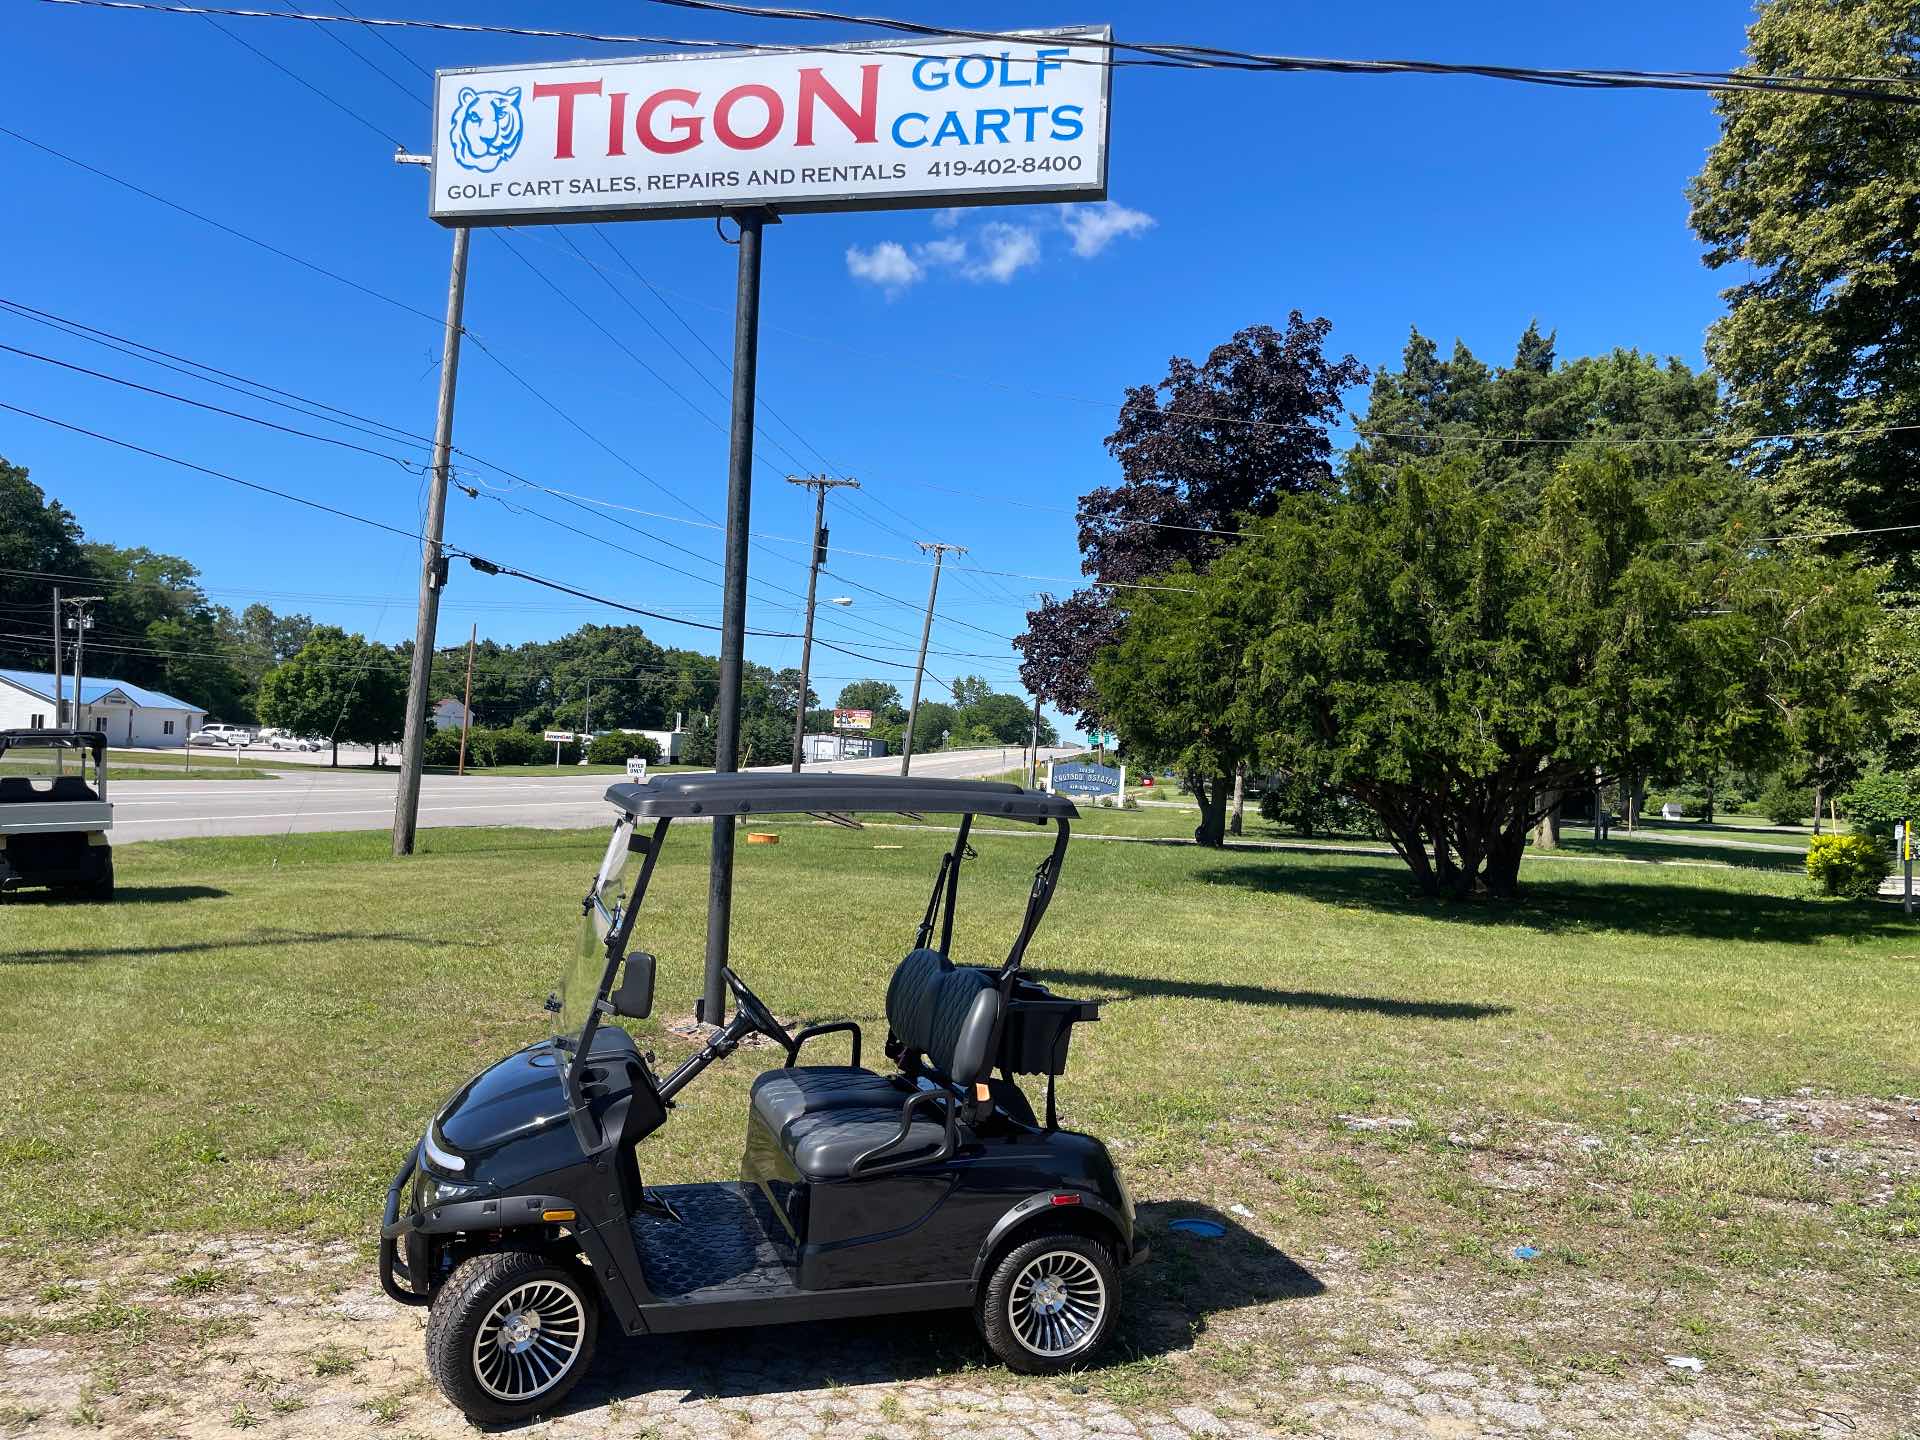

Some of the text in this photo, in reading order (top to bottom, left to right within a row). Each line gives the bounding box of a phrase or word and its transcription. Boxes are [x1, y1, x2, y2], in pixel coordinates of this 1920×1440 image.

[912, 48, 1070, 91] GOLF
[532, 64, 883, 161] TIGON
[891, 105, 1084, 148] CARTS
[447, 163, 907, 200] GOLF CART SALES, REPAIRS AND RENTALS
[927, 155, 1082, 177] 419-402-8400
